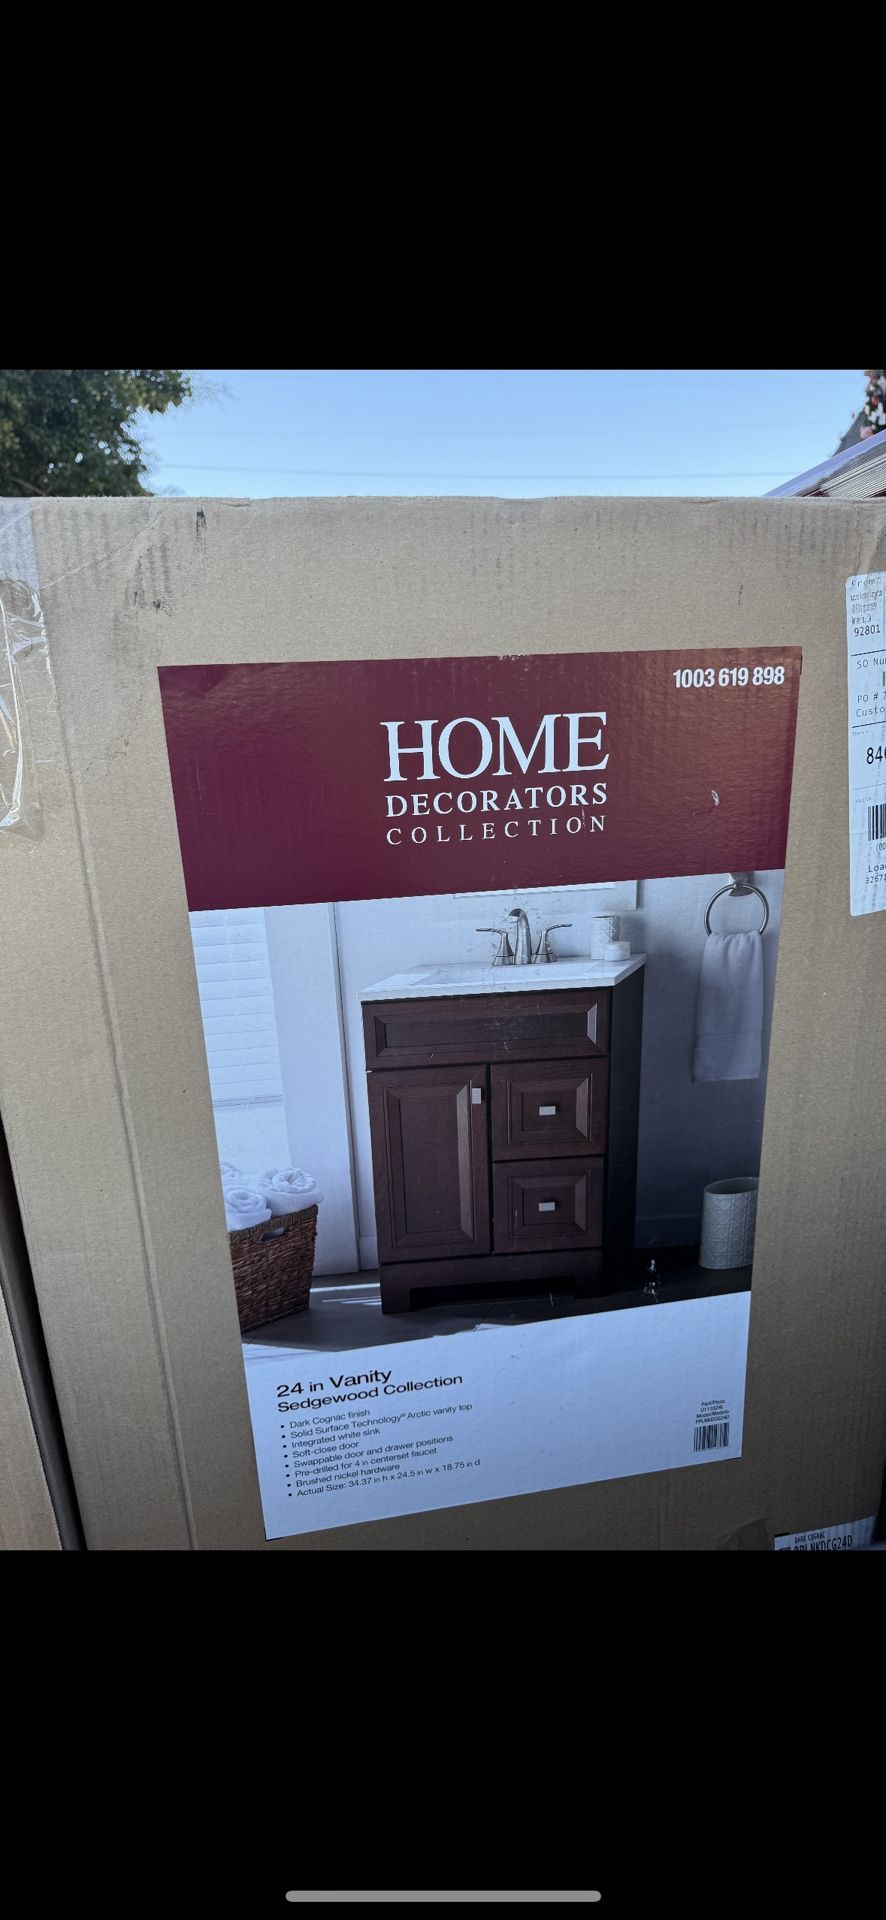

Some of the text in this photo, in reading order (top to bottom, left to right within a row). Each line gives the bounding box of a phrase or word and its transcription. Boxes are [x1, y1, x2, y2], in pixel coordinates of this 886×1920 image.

[854, 624, 880, 637] 92801
[673, 666, 785, 688] 1003 619 898
[380, 711, 610, 782] HOME
[867, 745, 886, 765] 84
[386, 783, 607, 818] DECORATORS
[386, 815, 606, 845] COLLECTION
[868, 864, 886, 873] Loa
[276, 1370, 392, 1397] 24 in Vanity
[277, 1375, 463, 1412] Sedgewood Collection
[290, 1409, 371, 1429] Dark Cognac finish
[290, 1429, 313, 1439] Solid
[315, 1423, 349, 1435] Surface
[407, 1409, 431, 1419] Arctic
[433, 1405, 457, 1415] vanity
[459, 1403, 473, 1412] top
[292, 1427, 381, 1449] Integrated white sink
[293, 1441, 360, 1458] Soft-close door
[294, 1435, 454, 1468] Swappable door and drawer positions
[295, 1463, 339, 1478] Pre-drilled
[341, 1461, 352, 1470] for
[354, 1459, 360, 1467] 4
[370, 1451, 409, 1465] centerset
[411, 1447, 437, 1458] faucet
[296, 1463, 400, 1488] Brushed nickel hardware
[297, 1486, 324, 1497] Actual
[326, 1482, 346, 1492] Size:
[348, 1477, 372, 1488] 34.37
[382, 1474, 388, 1482] h
[396, 1469, 415, 1479] 24.5
[417, 1468, 424, 1476] in
[442, 1460, 465, 1471] 18.75
[475, 1458, 481, 1466] d
